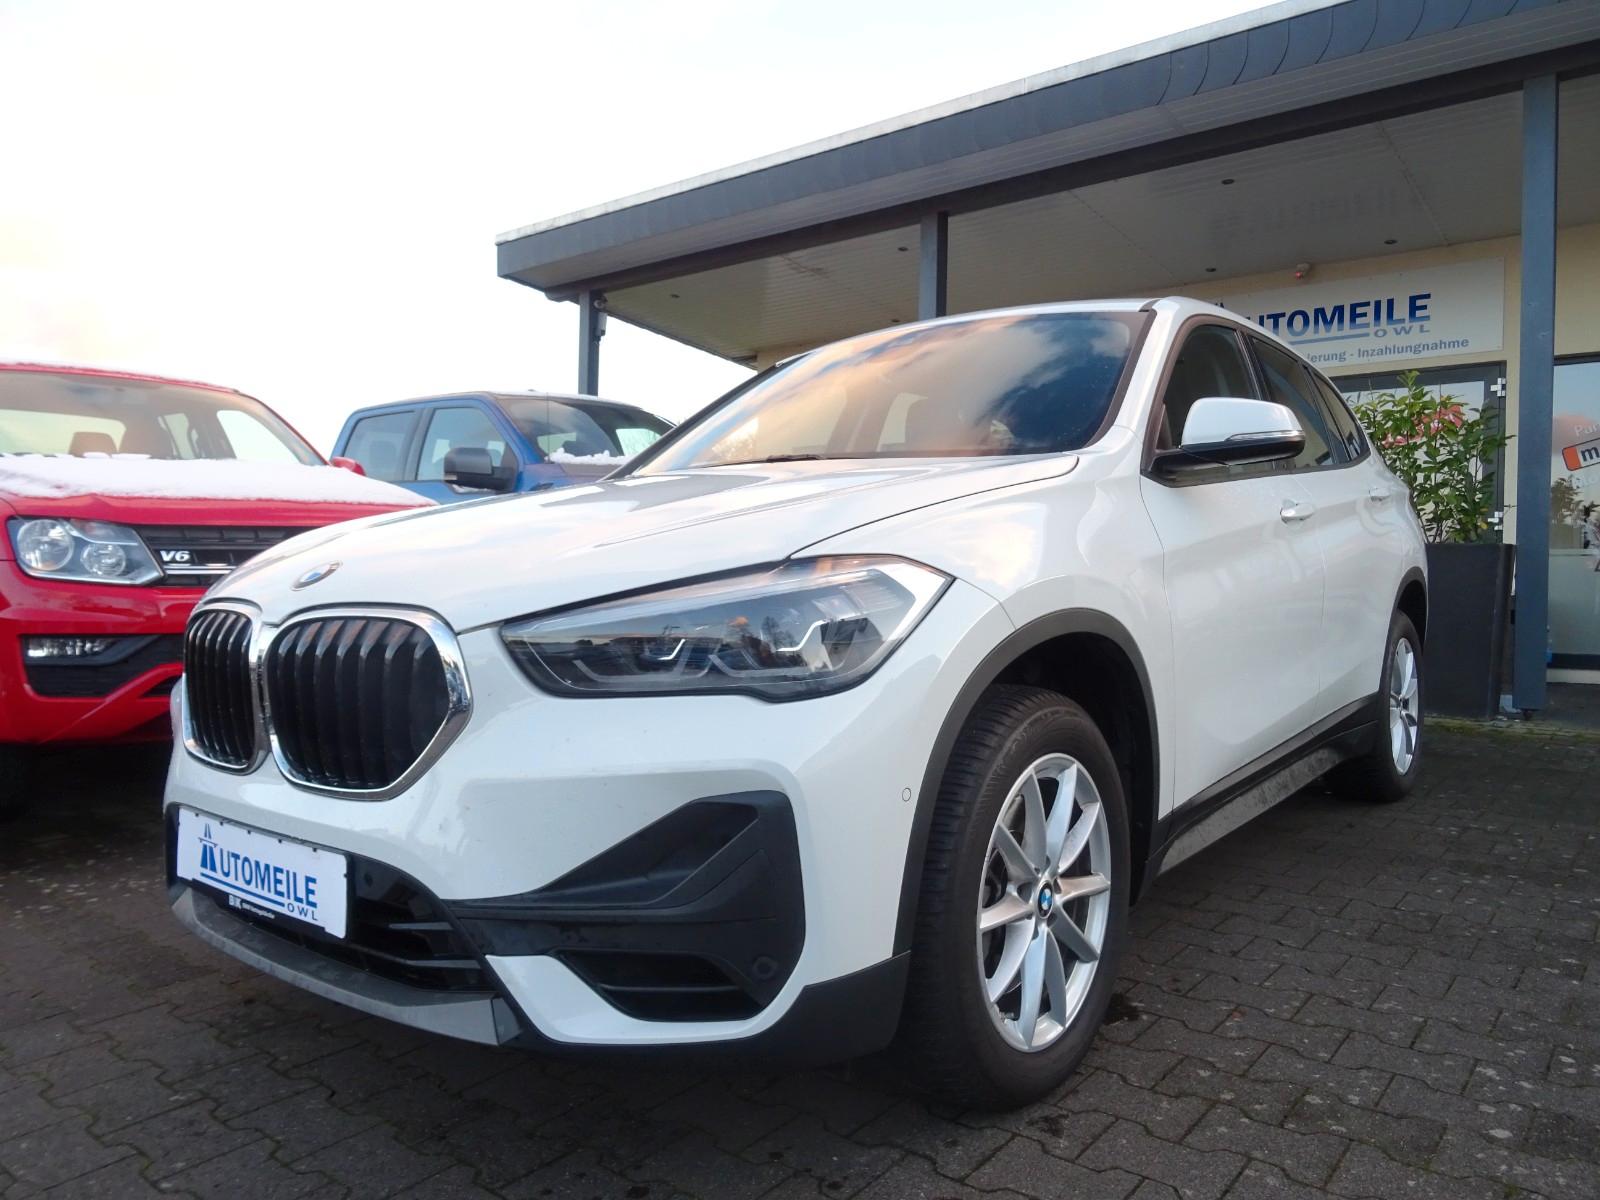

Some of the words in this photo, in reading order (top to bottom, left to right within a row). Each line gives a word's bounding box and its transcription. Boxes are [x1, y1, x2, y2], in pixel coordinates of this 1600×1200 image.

[1374, 324, 1430, 338] OWL
[1358, 338, 1470, 359] Inzahlungnahme
[160, 549, 192, 562] V6
[287, 902, 319, 921] OWL
